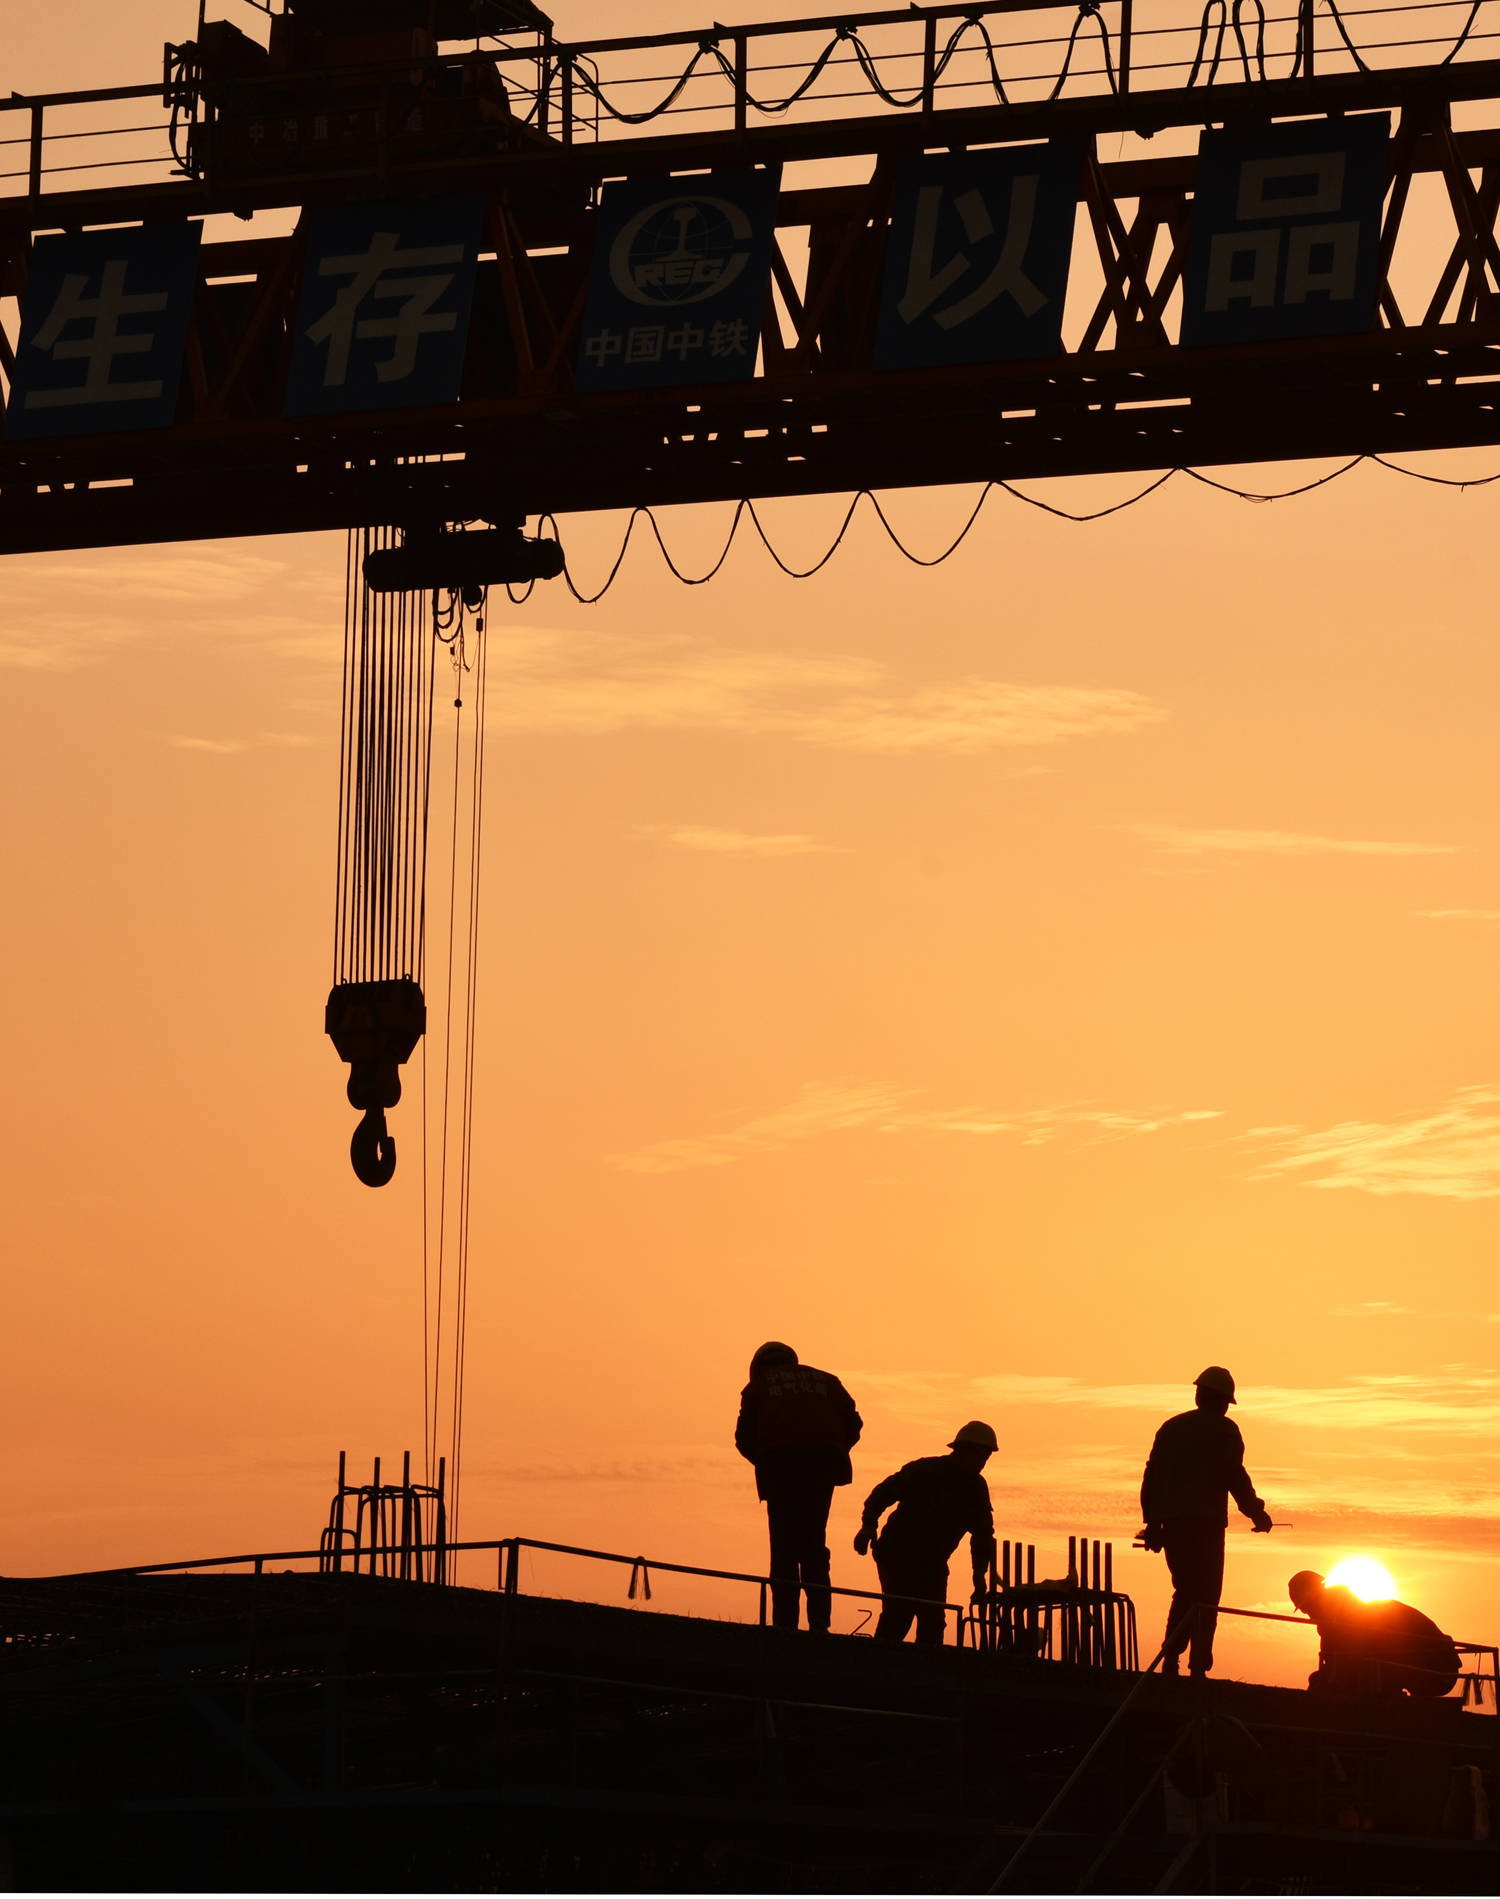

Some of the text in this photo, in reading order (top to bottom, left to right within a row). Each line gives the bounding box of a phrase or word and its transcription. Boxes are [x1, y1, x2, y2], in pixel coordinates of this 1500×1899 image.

[24, 232, 465, 410] 生存
[584, 318, 750, 368] 中国中铁
